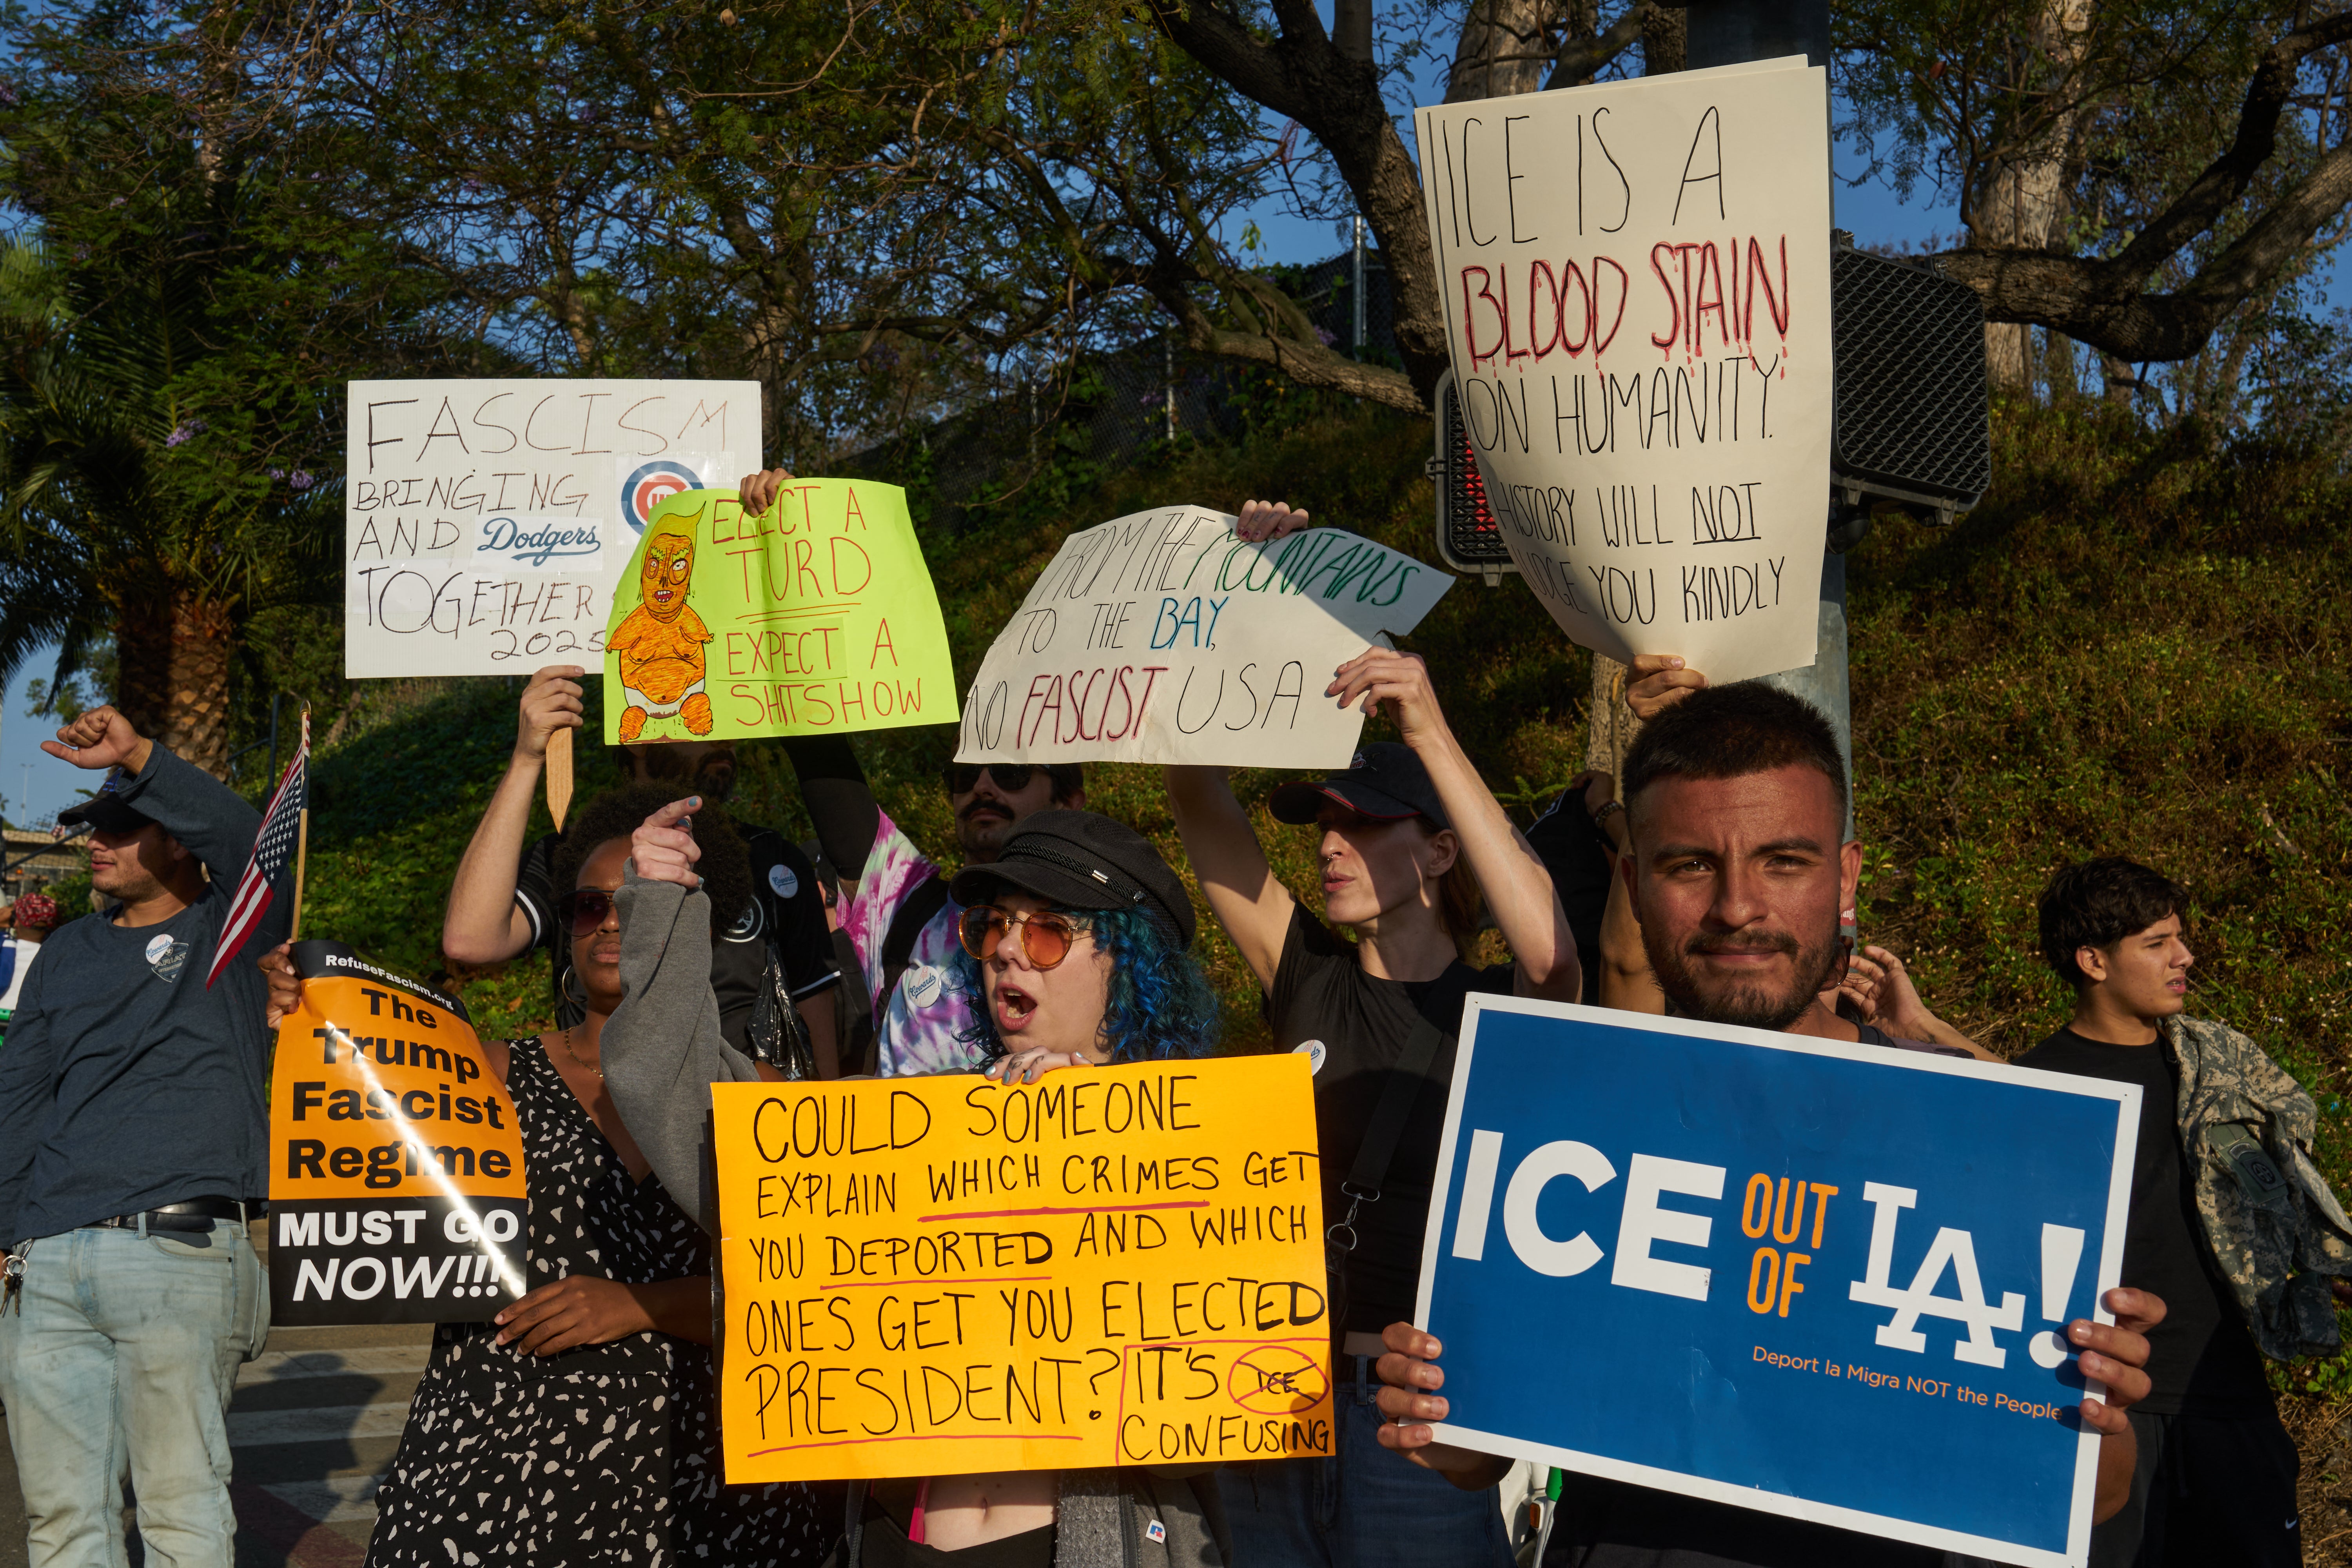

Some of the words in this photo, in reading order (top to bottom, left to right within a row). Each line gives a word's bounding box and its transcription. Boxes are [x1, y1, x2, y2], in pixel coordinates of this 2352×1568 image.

[1443, 116, 1538, 247] ICE
[1578, 107, 1630, 236] IS
[1672, 105, 1725, 226] A
[1462, 256, 1629, 365] BLOOD
[1651, 235, 1790, 359] STAIN
[367, 393, 728, 474] FASCISM
[1466, 377, 1529, 454] ON
[1552, 354, 1779, 456] HUMANITY.
[352, 473, 589, 517] BRINGING
[713, 486, 821, 544] ELECT
[845, 486, 867, 532] A
[1487, 477, 1576, 546] HISTORY
[1597, 484, 1674, 547] WILL
[1693, 482, 1762, 543] NOT
[354, 516, 460, 561] AND
[477, 517, 601, 567] Dodgers
[725, 537, 871, 603] TURD
[1035, 517, 1152, 606] FROM
[1134, 512, 1216, 591] THE
[1183, 528, 1420, 606] MOUNTAINS
[358, 566, 593, 640] TOGETHER
[1511, 543, 1588, 614] JUDGE
[1588, 564, 1655, 624] YOU
[1682, 555, 1785, 623] KINDLY
[490, 629, 606, 660] 2025
[726, 627, 839, 675] EXPECT
[870, 618, 898, 670] A
[1018, 608, 1056, 655] TO
[1087, 601, 1136, 650] THE
[1150, 596, 1229, 652] BAY,
[731, 677, 921, 726] SHITSHOW
[962, 680, 1007, 754] NO
[1017, 665, 1169, 750] FASCIST
[1176, 661, 1303, 733] USA
[146, 939, 172, 958] Cowards
[155, 952, 187, 968] ARIAT
[326, 955, 454, 1011] RefuseFascism.org
[361, 988, 437, 1029] The
[909, 973, 936, 999] Cowards
[313, 1028, 480, 1084] Trump
[292, 1081, 505, 1130] Fascist
[753, 1090, 931, 1163] COULD
[966, 1075, 1201, 1143] SOMEONE
[287, 1138, 511, 1189] Regime
[758, 1171, 896, 1219] EXPLAIN
[927, 1152, 1040, 1203] WHICH
[1062, 1155, 1220, 1194] CRIMES
[1243, 1151, 1319, 1189] GET
[279, 1209, 426, 1247] MUST
[443, 1209, 519, 1243] GO
[749, 1233, 804, 1283] YOU
[829, 1231, 1054, 1277] DEPORTED
[1074, 1212, 1167, 1258] AND
[1190, 1205, 1308, 1249] WHICH
[1452, 1129, 1727, 1302] ICE
[1741, 1172, 1839, 1250] OUT
[292, 1255, 506, 1301] NOW!!!
[1746, 1246, 1812, 1318] OF
[1848, 1181, 2086, 1370] LA!
[745, 1296, 855, 1357] ONES
[878, 1292, 975, 1351] GET
[999, 1286, 1072, 1347] YOU
[1102, 1277, 1325, 1341] ELECTED
[745, 1347, 1121, 1441] PRESIDENT?
[1136, 1346, 1218, 1404] IT'S
[1258, 1371, 1299, 1395] ICE
[1753, 1346, 1819, 1373] Deport
[1825, 1356, 1840, 1377] la
[1847, 1364, 1900, 1388] Migra
[1907, 1376, 1951, 1398] NOT
[1956, 1386, 1989, 1406] the
[1994, 1393, 2063, 1421] People
[1121, 1413, 1330, 1461] CONFUSING
